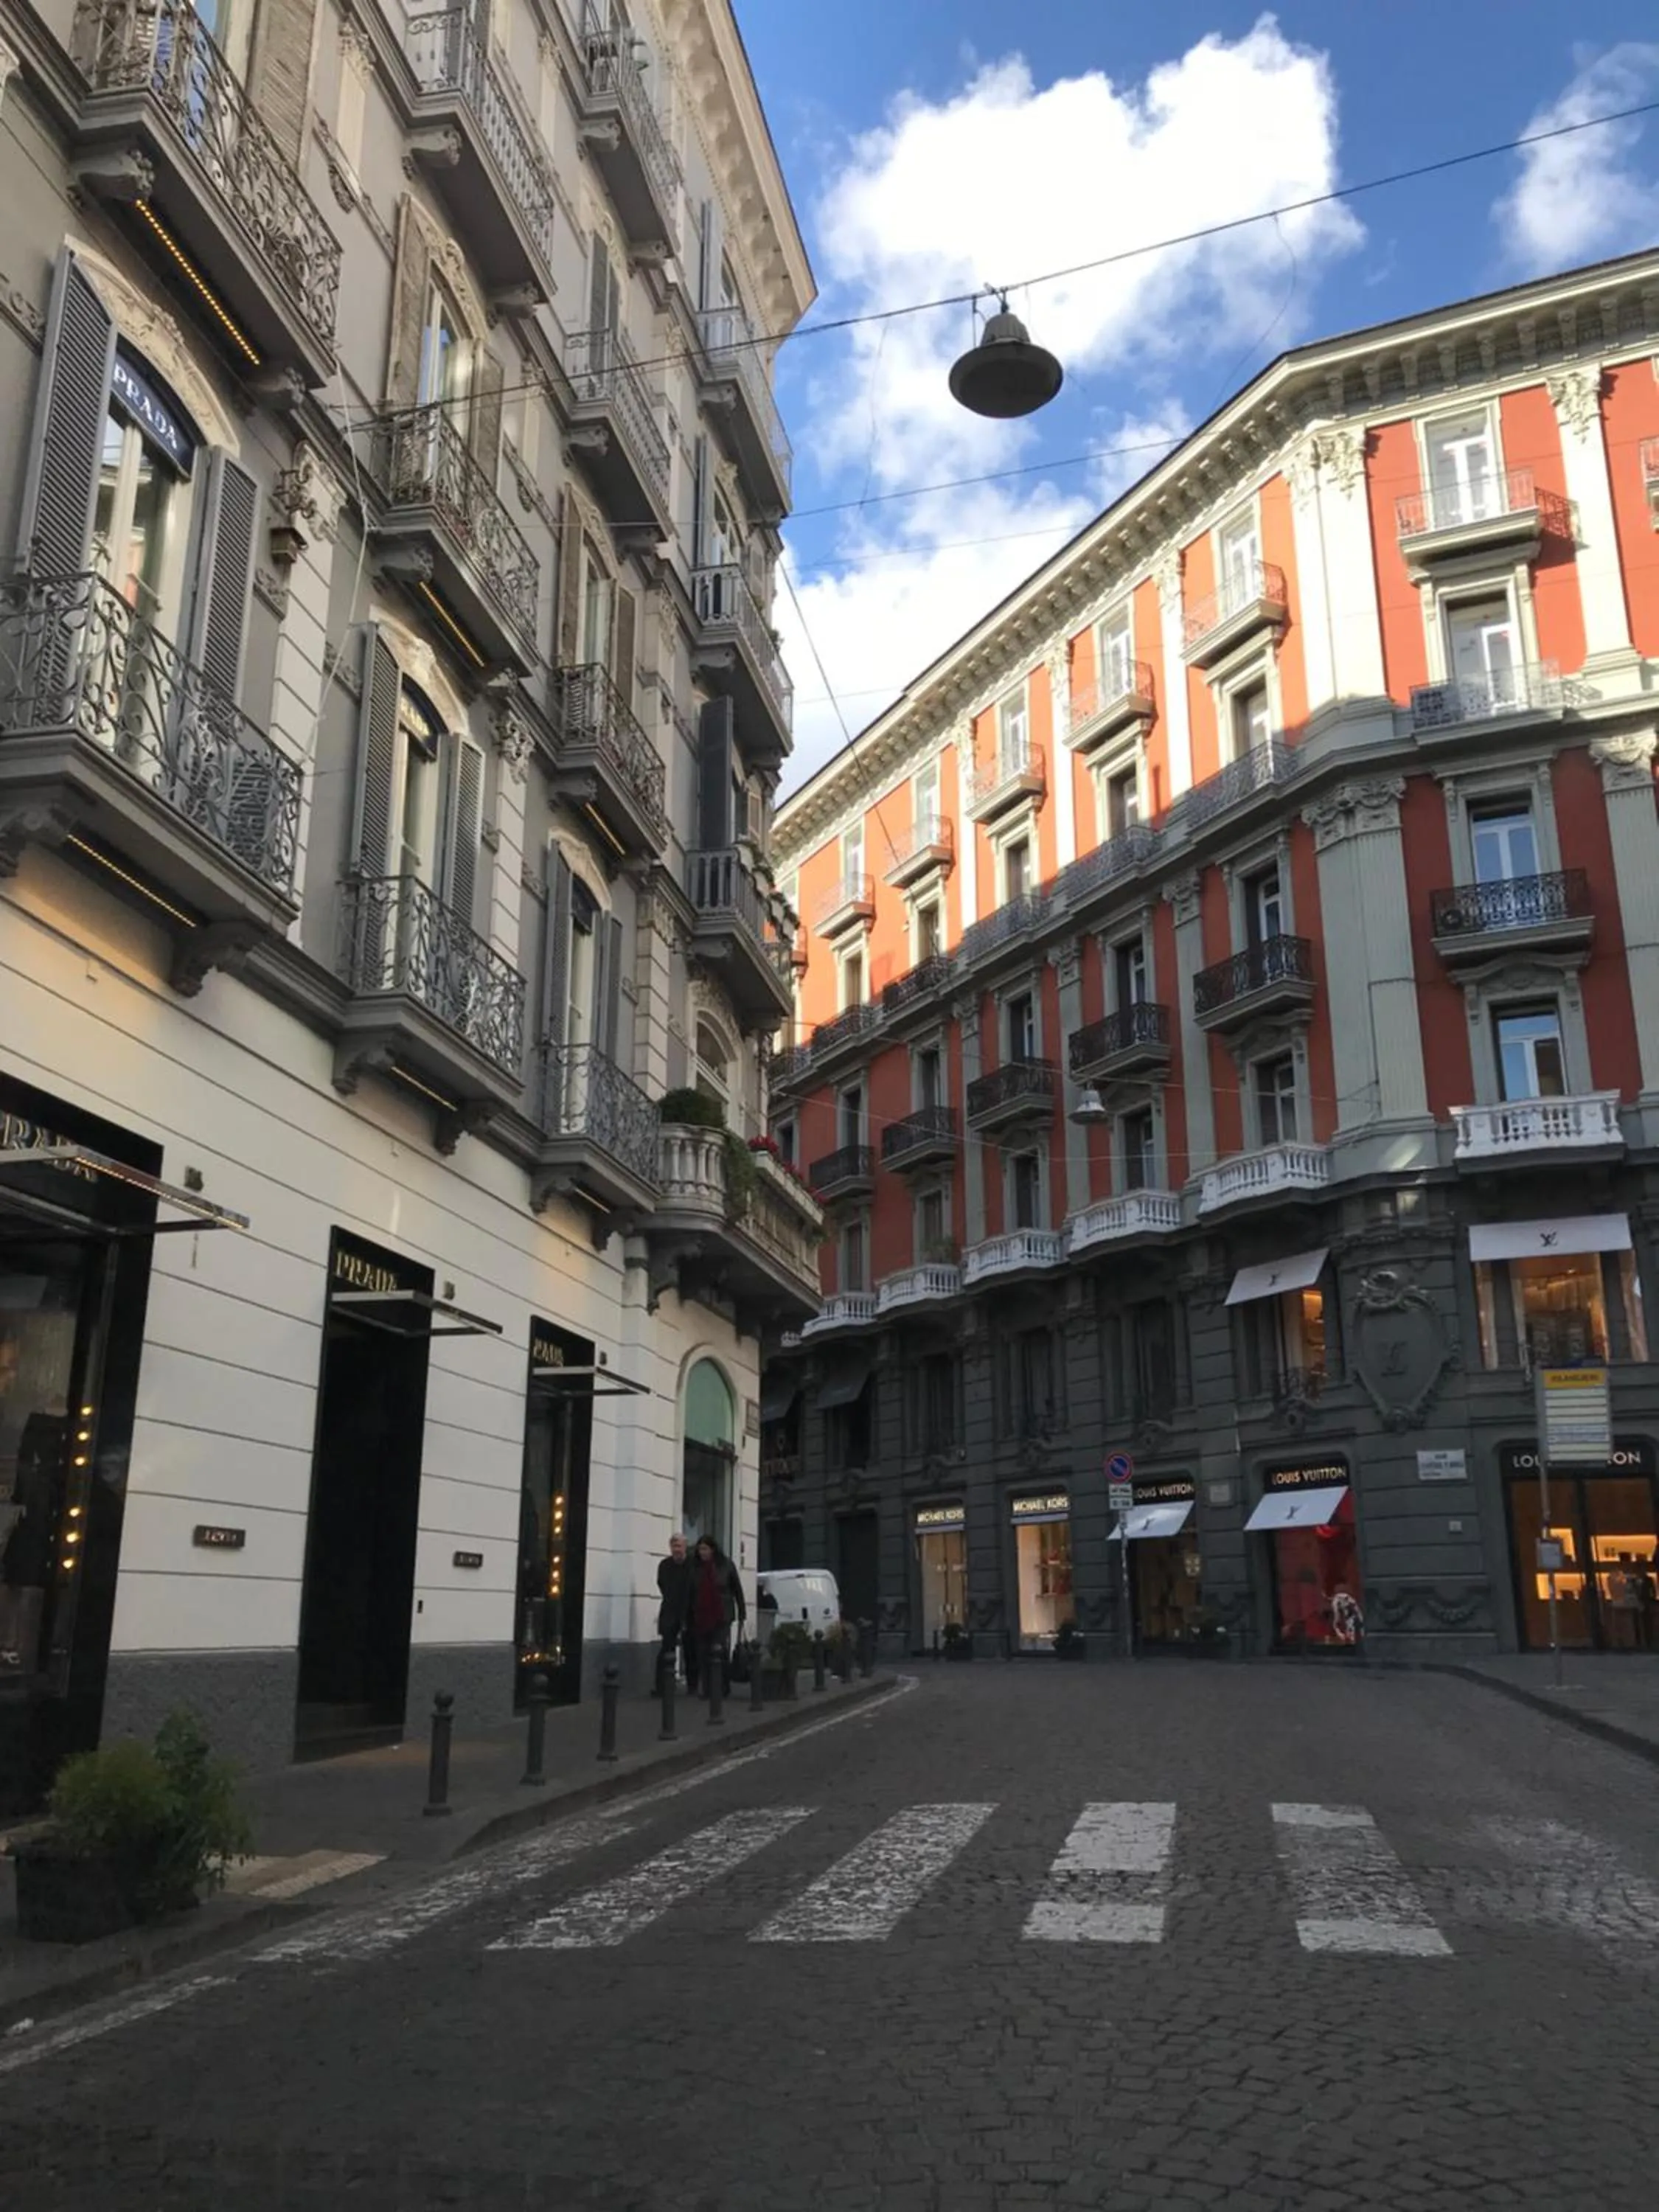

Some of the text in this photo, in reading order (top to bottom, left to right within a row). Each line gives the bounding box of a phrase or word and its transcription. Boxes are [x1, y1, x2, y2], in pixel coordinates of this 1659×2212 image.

[113, 363, 178, 449] PRADA
[335, 1251, 398, 1293] PRADA
[1273, 1467, 1346, 1485] LOUIS VUITTON
